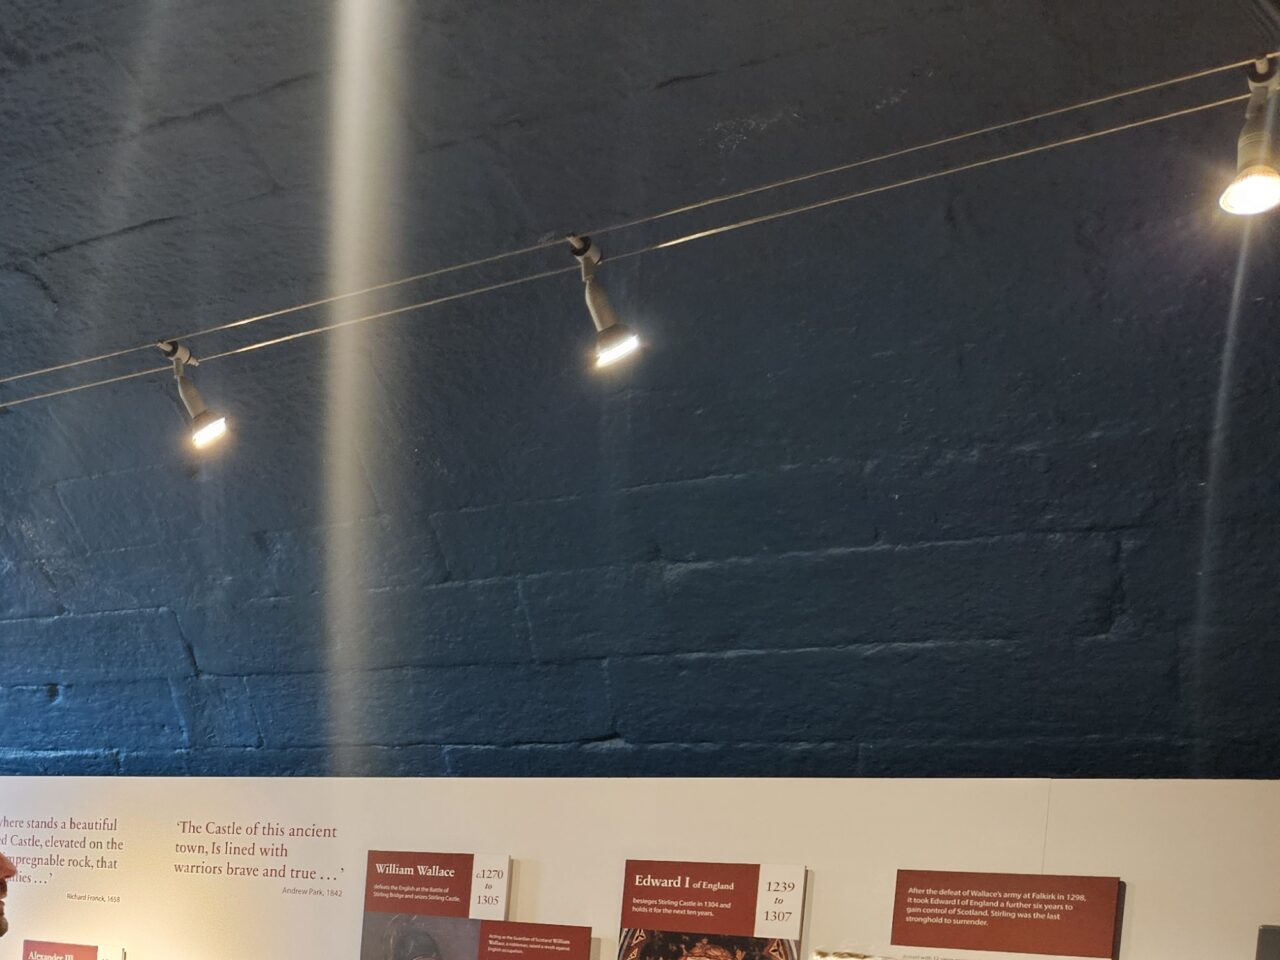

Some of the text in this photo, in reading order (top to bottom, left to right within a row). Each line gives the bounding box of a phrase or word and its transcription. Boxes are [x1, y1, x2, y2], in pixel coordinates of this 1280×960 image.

[26, 817, 58, 829] stands
[60, 821, 66, 830] a
[69, 817, 117, 831] beautiful
[205, 821, 242, 835] Castle
[245, 822, 260, 835] of
[262, 822, 285, 837] this
[289, 824, 337, 838] ancient
[10, 835, 42, 848] Castle,
[45, 836, 86, 849] elevated
[89, 840, 103, 850] on
[106, 837, 124, 850] the
[175, 842, 288, 857] town, Is lined with
[7, 853, 117, 869] mpregnable rock, that
[174, 861, 317, 880] warriors brave and true
[376, 863, 456, 877] William Wallace
[635, 874, 734, 891] Edward I of England
[767, 881, 795, 893] 1239
[282, 886, 343, 897] Andrew Park, 1842
[908, 887, 925, 895] After
[1003, 892, 1021, 900] army
[1032, 892, 1056, 900] Falkirk
[1066, 894, 1087, 902] 1298,
[477, 896, 499, 905] 1305
[632, 897, 658, 905] besieges
[774, 897, 783, 905] to
[970, 900, 998, 908] England
[1006, 901, 1031, 909] further
[765, 911, 792, 922] 1307
[957, 908, 989, 916] Scotland.
[991, 910, 1016, 919] Stirling
[906, 916, 943, 924] stronghold
[953, 918, 989, 926] surrender.
